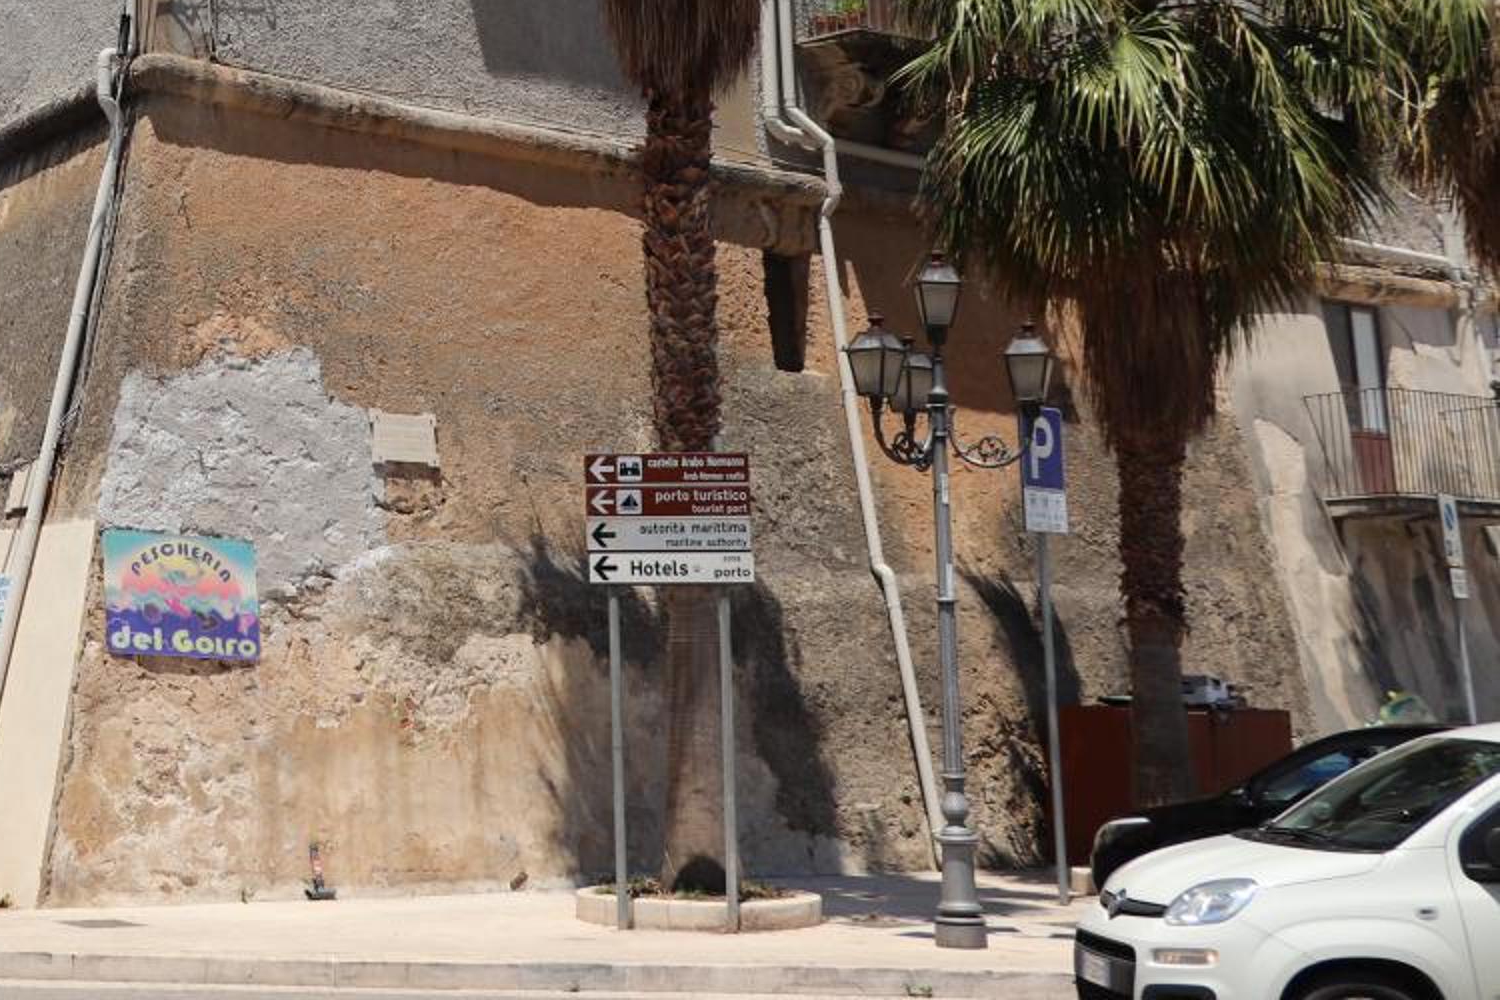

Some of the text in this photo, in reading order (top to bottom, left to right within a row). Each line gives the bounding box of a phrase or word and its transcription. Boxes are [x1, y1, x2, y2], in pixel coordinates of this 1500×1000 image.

[1030, 415, 1054, 479] P
[655, 489, 747, 504] porto turistico
[691, 504, 748, 515] tourist port
[639, 522, 747, 534] autorità marittima
[707, 537, 747, 548] authority
[131, 543, 231, 583] PESCHERIA
[630, 559, 689, 577] Hotels
[713, 567, 751, 579] porto
[110, 625, 164, 651] del
